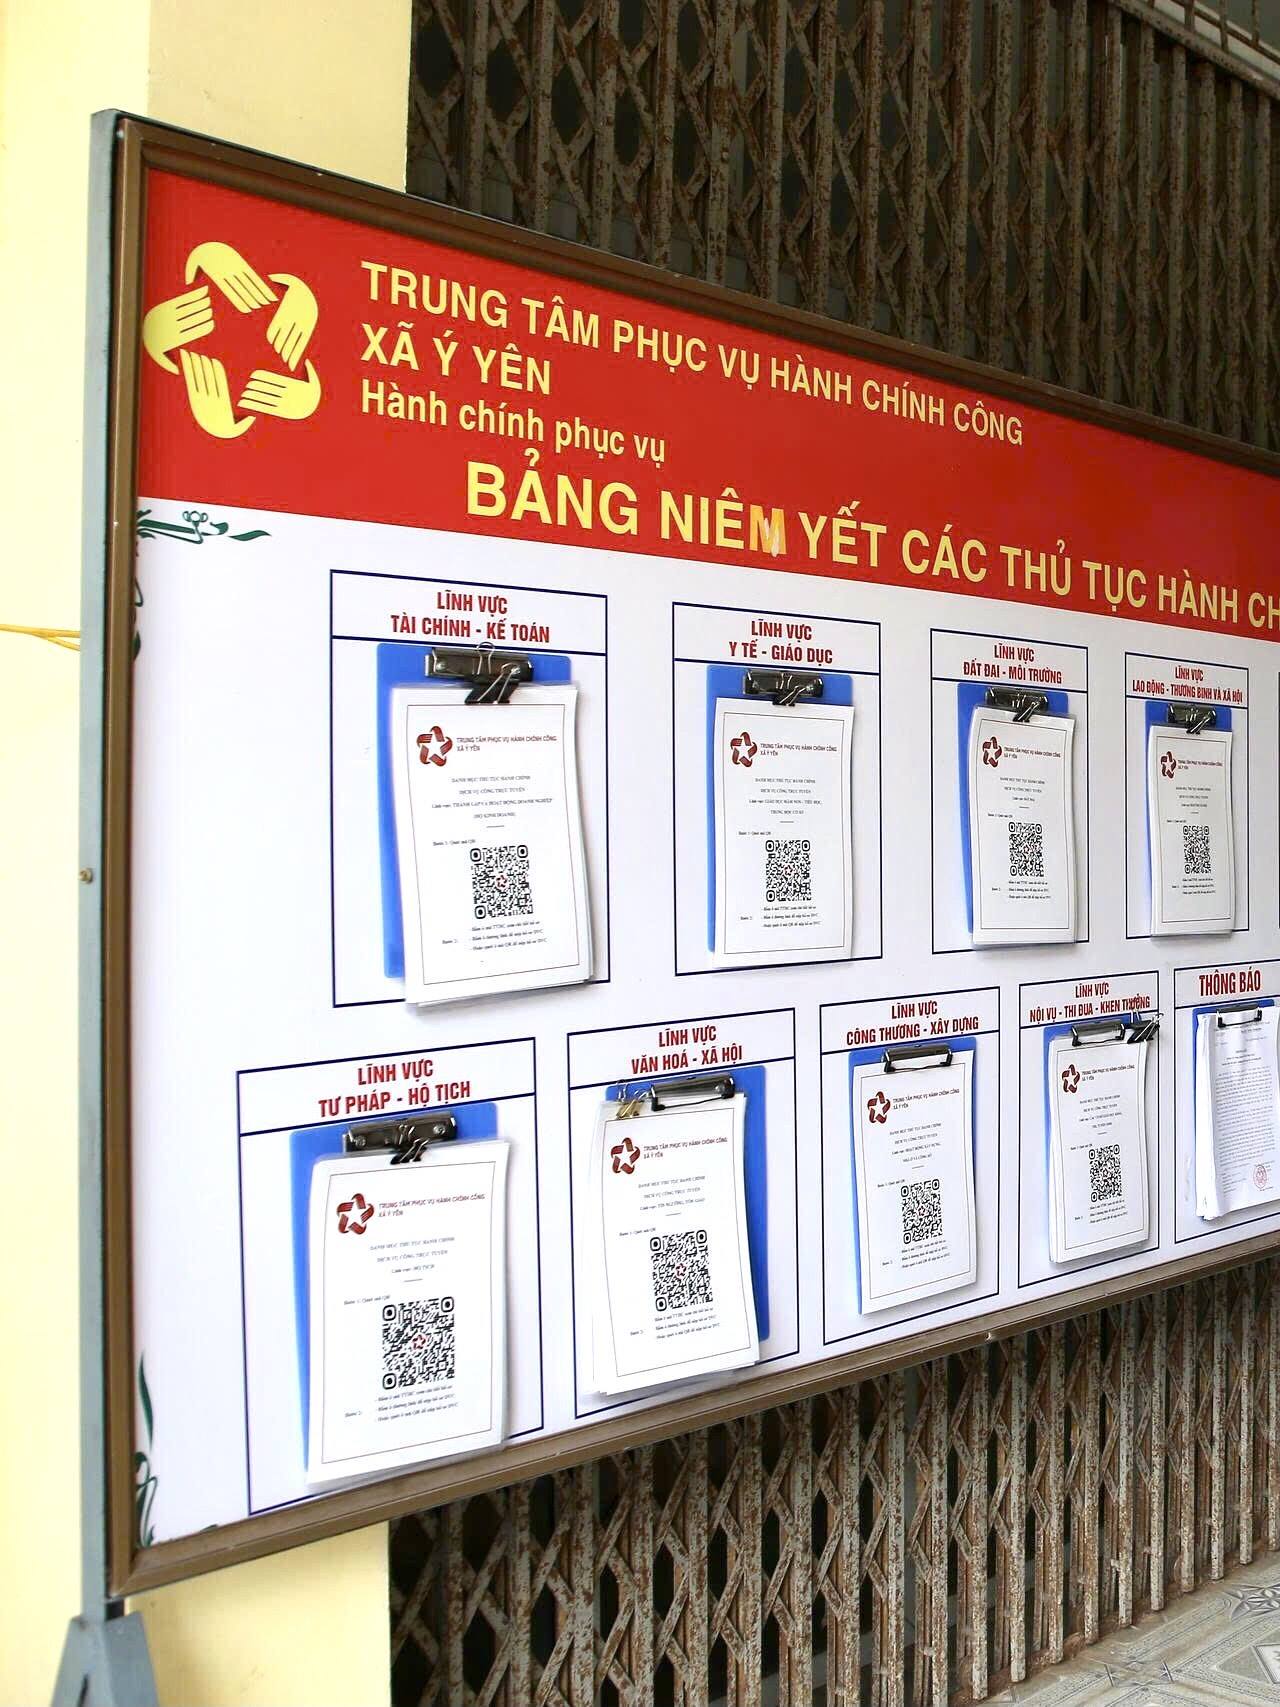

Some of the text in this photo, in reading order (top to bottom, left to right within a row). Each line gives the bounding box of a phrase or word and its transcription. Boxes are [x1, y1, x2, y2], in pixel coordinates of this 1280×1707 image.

[360, 261, 1023, 446] TRUNG TÂM PHỤC VỤ HÀNH CHÍNH CÔNG
[360, 323, 551, 395] XÃ Ý YÊN
[362, 379, 665, 468] Hành chính phục vụ
[467, 447, 638, 535] BẢNG
[660, 486, 786, 557] NIÊM
[796, 499, 887, 569] YẾT
[901, 524, 988, 584] CÁC
[1000, 539, 1072, 596] THỦ
[1082, 560, 1147, 613] TỤC
[1157, 571, 1238, 625] HÀNH
[437, 589, 508, 617] LĨNH VỰC
[390, 612, 416, 634] TÀI
[421, 616, 471, 637] CHÍNH
[487, 618, 506, 640] KẾ
[510, 622, 550, 643] TOÁN
[751, 618, 812, 643] LĨNH VỰC
[729, 641, 737, 657] Y
[742, 639, 758, 658] TẾ
[771, 643, 803, 662] GIÁO
[807, 648, 833, 666] DỤC
[994, 642, 1035, 665] LĨNH VỰC
[963, 658, 982, 676] ĐẤT
[984, 663, 1000, 678] ĐAI
[1008, 664, 1026, 680] MÔI
[1028, 667, 1062, 684] TRƯỜNG
[1175, 665, 1204, 683] LĨNH VỰC
[1132, 680, 1145, 693] LAO
[1146, 680, 1165, 696] ĐỘNG
[1171, 683, 1195, 698] THƯƠNG
[1197, 686, 1212, 699] BINH
[1213, 687, 1221, 700] VÀ
[1223, 688, 1231, 701] XÃ
[1232, 689, 1243, 704] HỘI
[1075, 981, 1110, 998] LĨNH VỰC
[1199, 966, 1261, 997] THÔNG BÁO
[891, 1000, 938, 1019] LĨNH VỰC
[1029, 1006, 1044, 1025] NỘI
[1046, 1006, 1057, 1023] VỤ
[1064, 1004, 1076, 1018] THI
[1078, 1002, 1093, 1017] ĐUA
[1100, 999, 1120, 1014] KHEN
[658, 1025, 716, 1047] LĨNH VỰC
[846, 1028, 876, 1046] CÔNG
[879, 1023, 920, 1041] THƯƠNG
[930, 1018, 949, 1035] XÂY
[952, 1016, 979, 1035] DỰNG
[631, 1054, 658, 1074] VĂN
[662, 1050, 689, 1070] HOÁ
[702, 1046, 718, 1065] XÃ
[722, 1042, 742, 1064] HỘI
[358, 1059, 433, 1085] LĨNH VỰC
[318, 1096, 341, 1117] TƯ
[345, 1089, 390, 1114] PHÁP
[408, 1083, 429, 1107] HỘ
[435, 1081, 470, 1104] TỊCH
